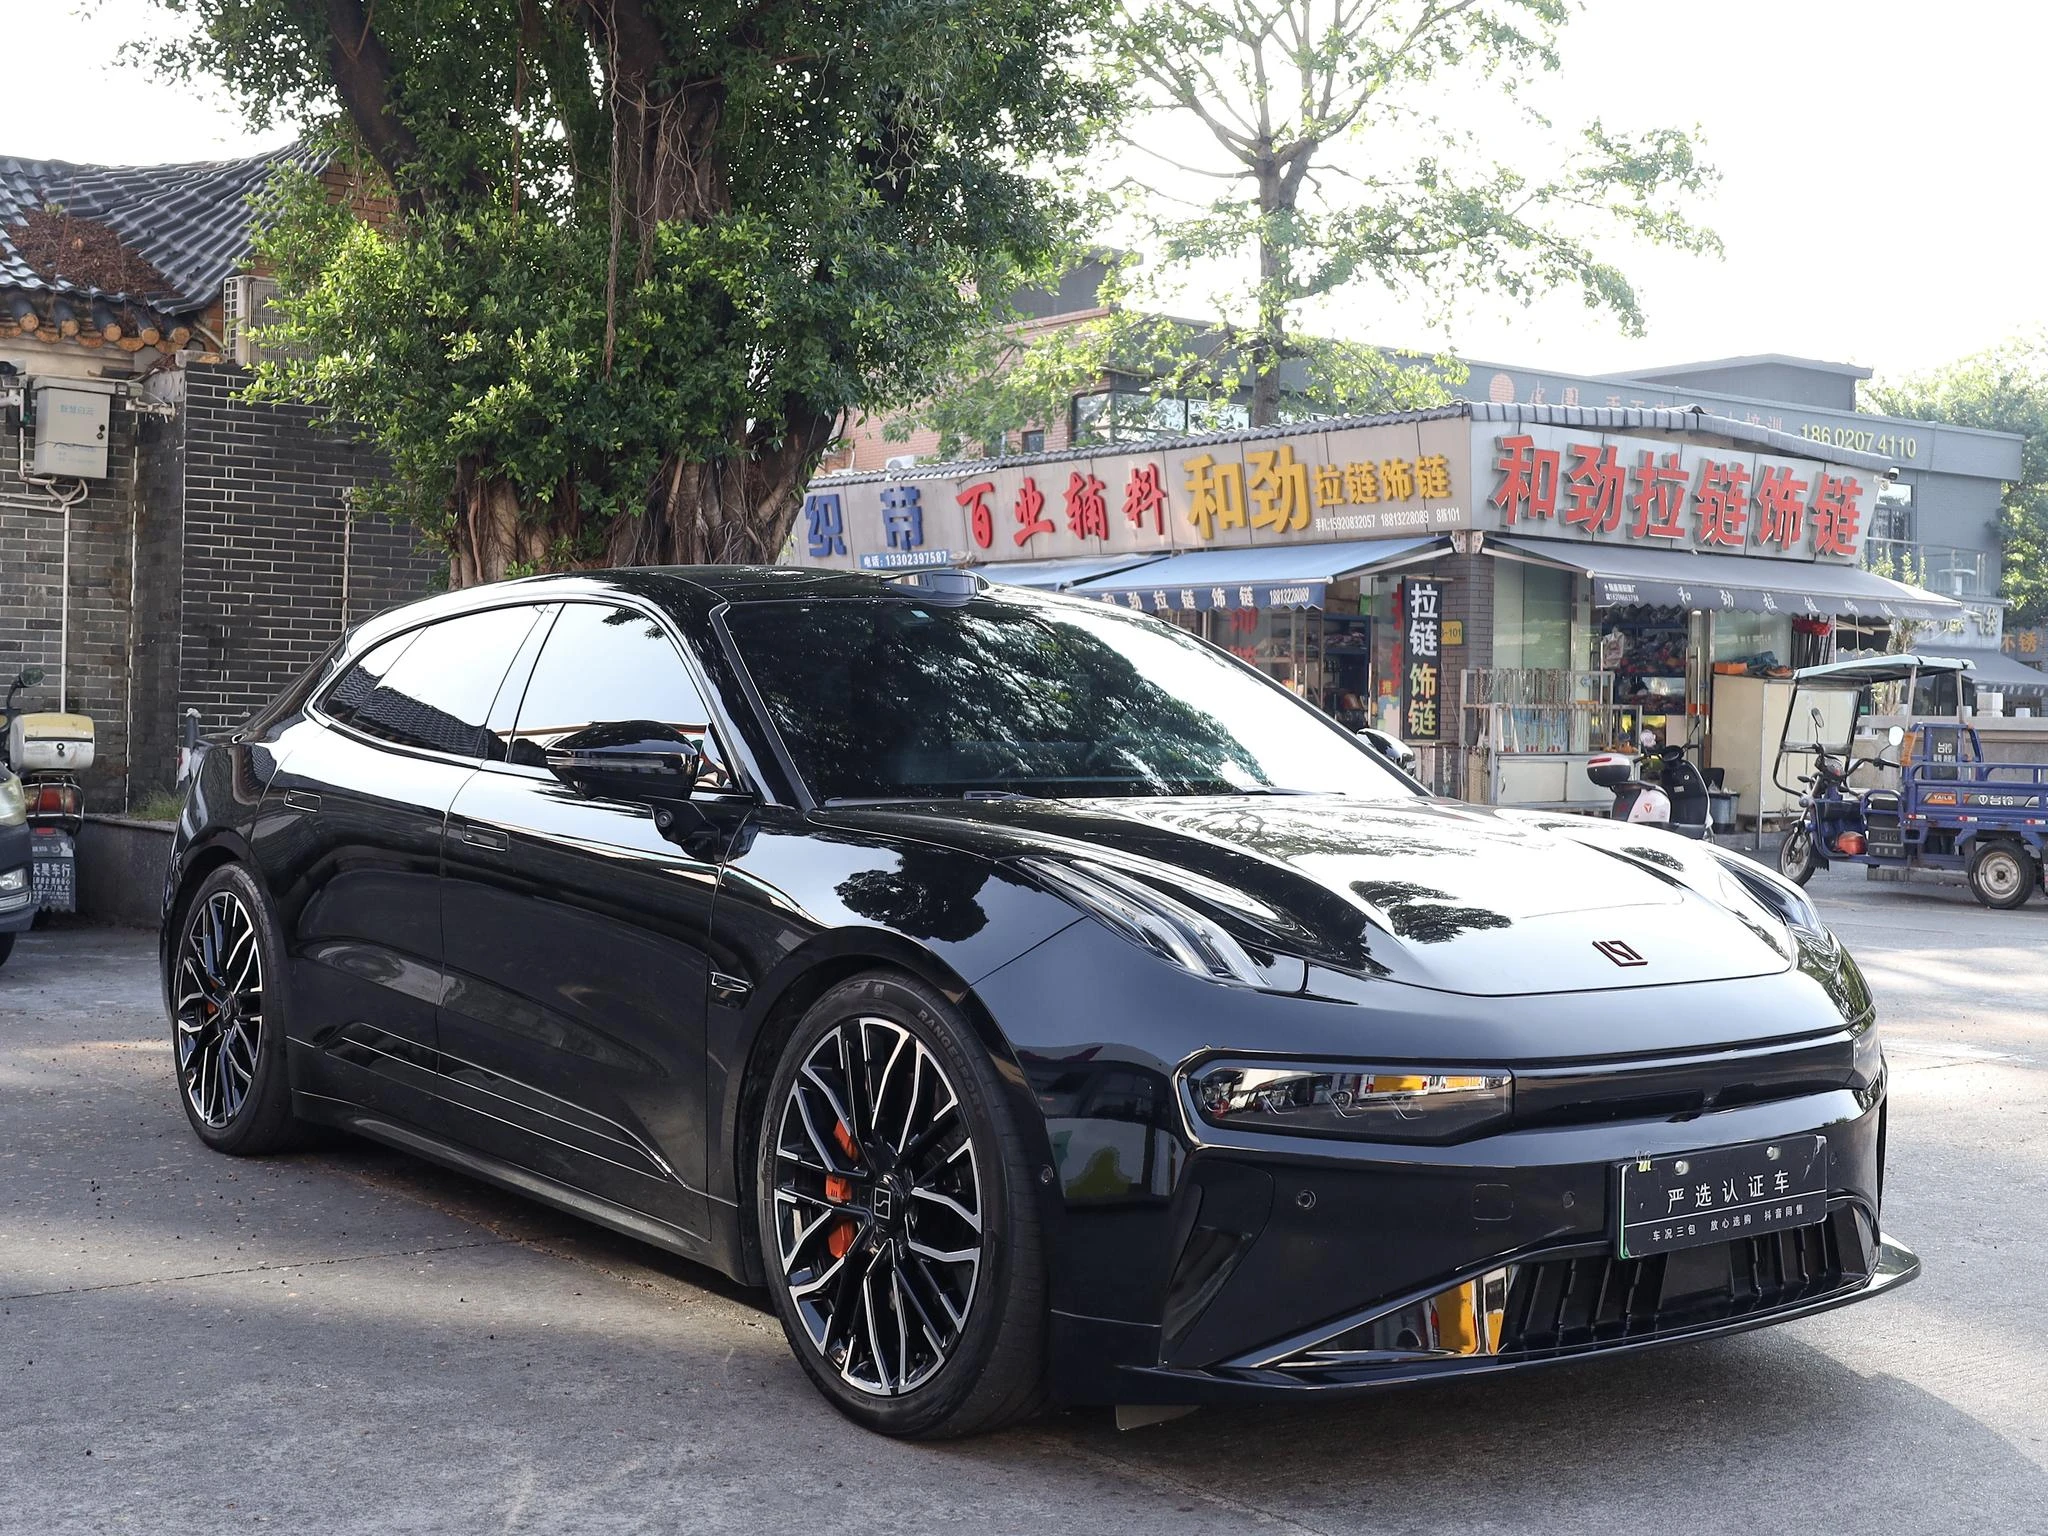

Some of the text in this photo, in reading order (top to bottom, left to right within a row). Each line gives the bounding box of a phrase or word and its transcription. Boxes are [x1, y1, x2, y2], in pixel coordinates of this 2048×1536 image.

[1802, 423, 1917, 459] 186 0207 4110
[804, 485, 925, 557] 织带
[956, 462, 1168, 549] 百业辅料
[1183, 444, 1453, 540] 和劲 拉链饰链
[1380, 510, 1429, 528] 18813228089
[1490, 434, 1865, 556] 和劲拉链饰链
[1408, 583, 1438, 736] 拉链饰链
[2001, 630, 2048, 654] 不锈
[1667, 1169, 1789, 1214] 严选认证车
[1652, 1224, 1697, 1242] 车况三包
[1710, 1214, 1752, 1231] 放心选购
